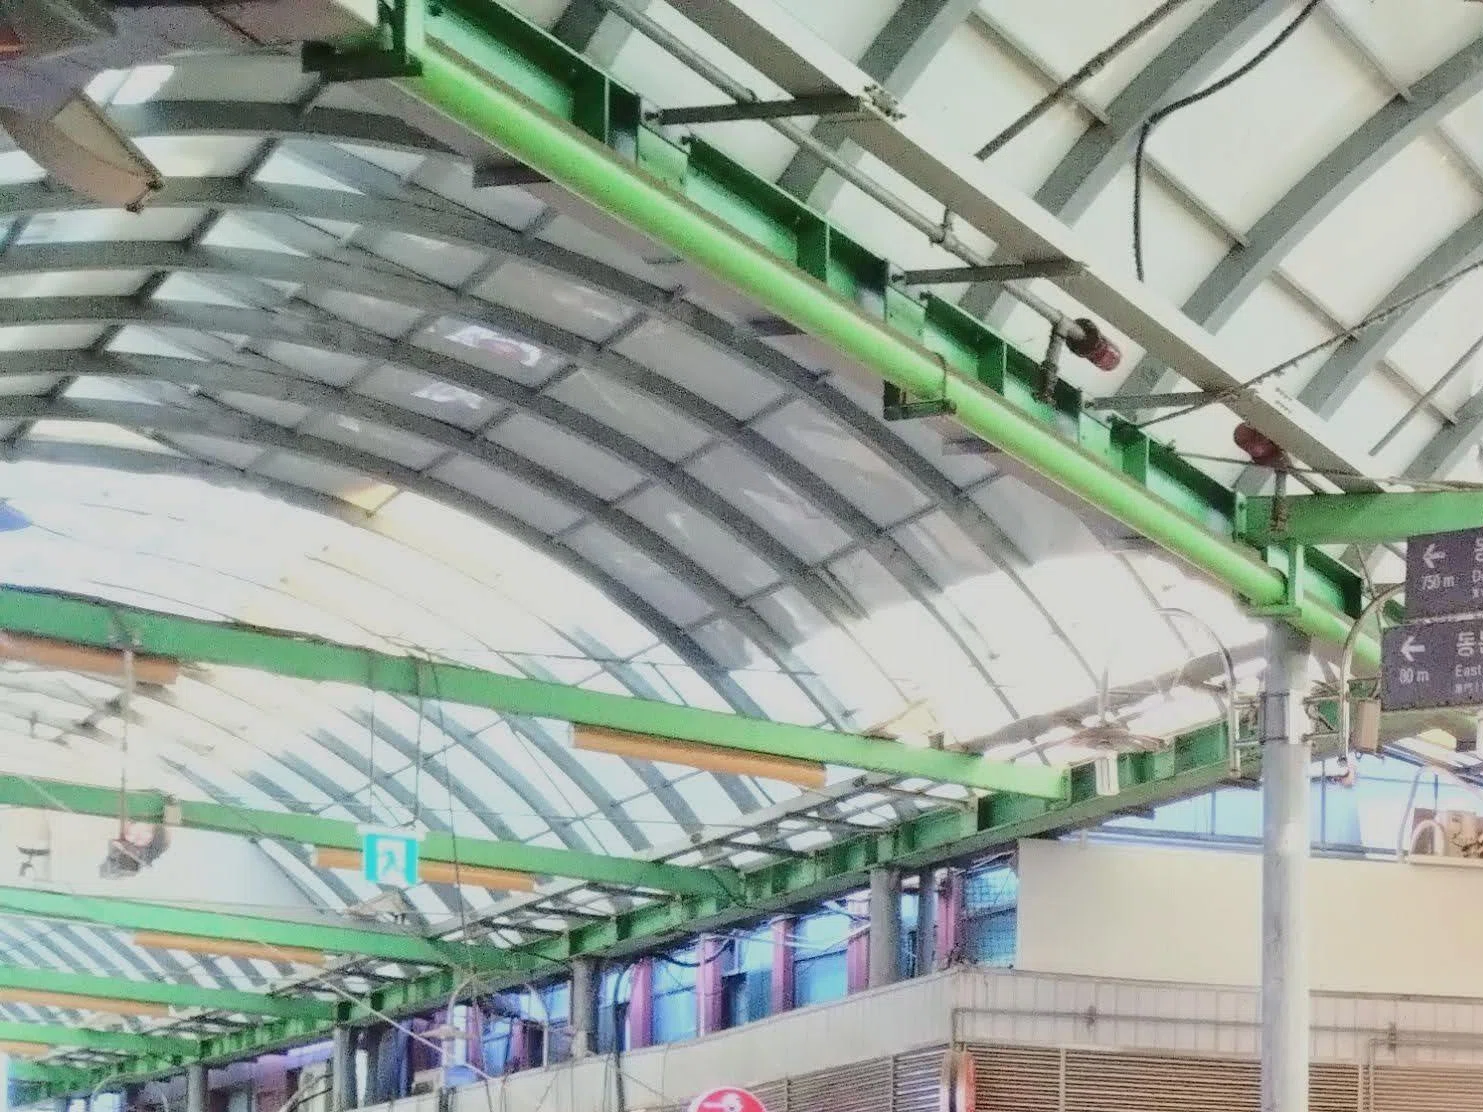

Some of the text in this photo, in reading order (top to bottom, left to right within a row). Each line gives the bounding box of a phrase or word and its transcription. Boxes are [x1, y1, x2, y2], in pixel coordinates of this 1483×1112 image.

[1443, 574, 1455, 587] m
[1416, 669, 1430, 682] m
[1455, 663, 1482, 677] East
